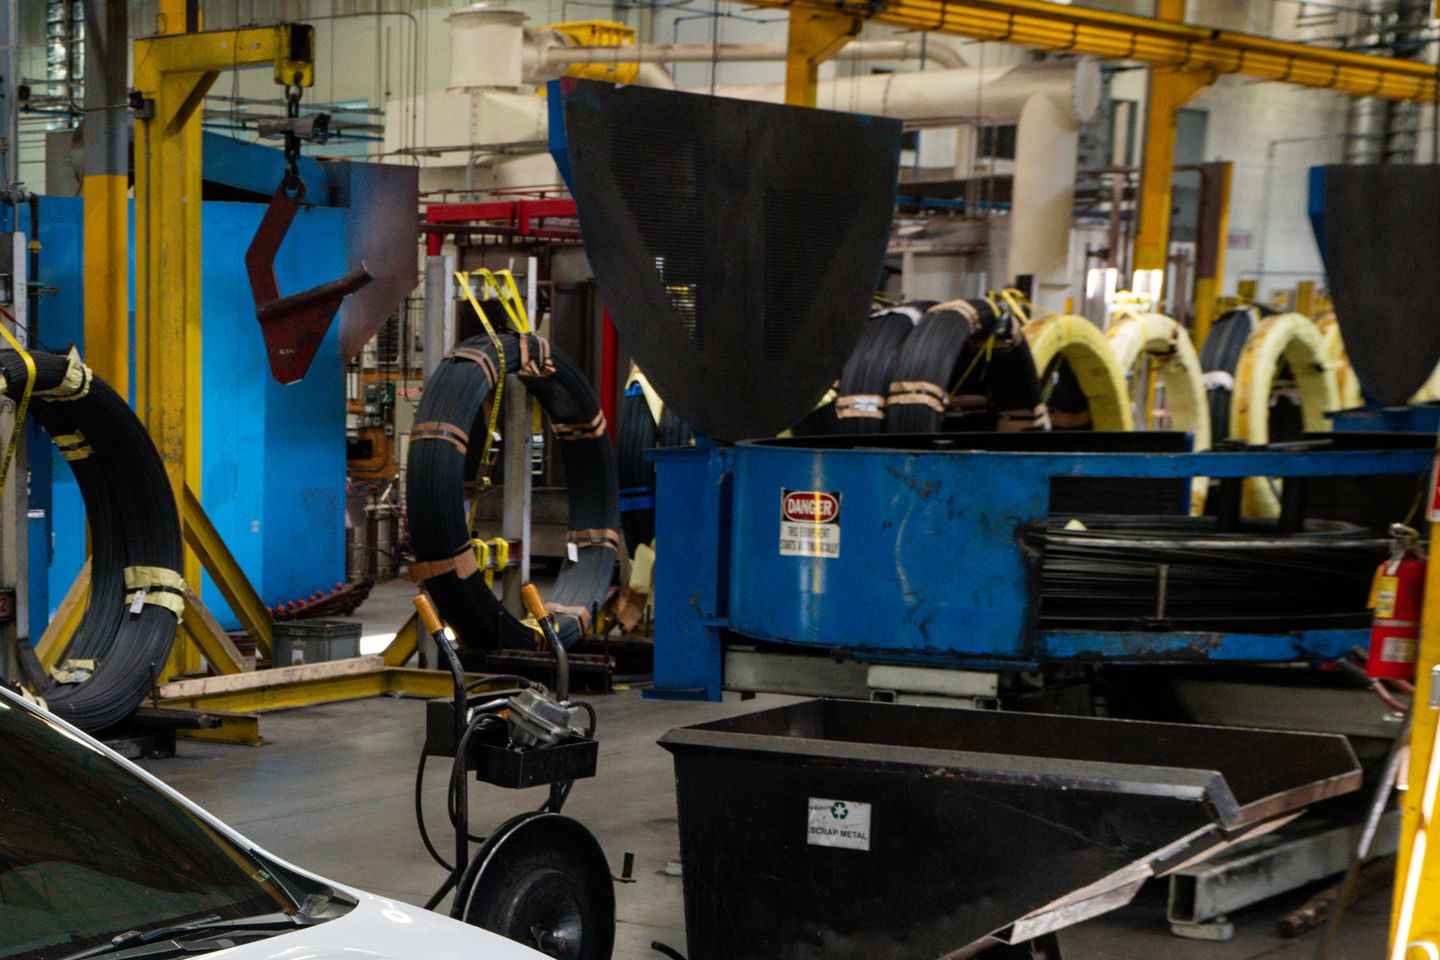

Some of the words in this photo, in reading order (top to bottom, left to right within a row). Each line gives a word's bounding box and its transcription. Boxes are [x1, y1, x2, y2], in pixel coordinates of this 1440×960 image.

[787, 498, 833, 516] DANGER
[810, 827, 839, 836] SCRAP
[840, 830, 868, 840] METAL
